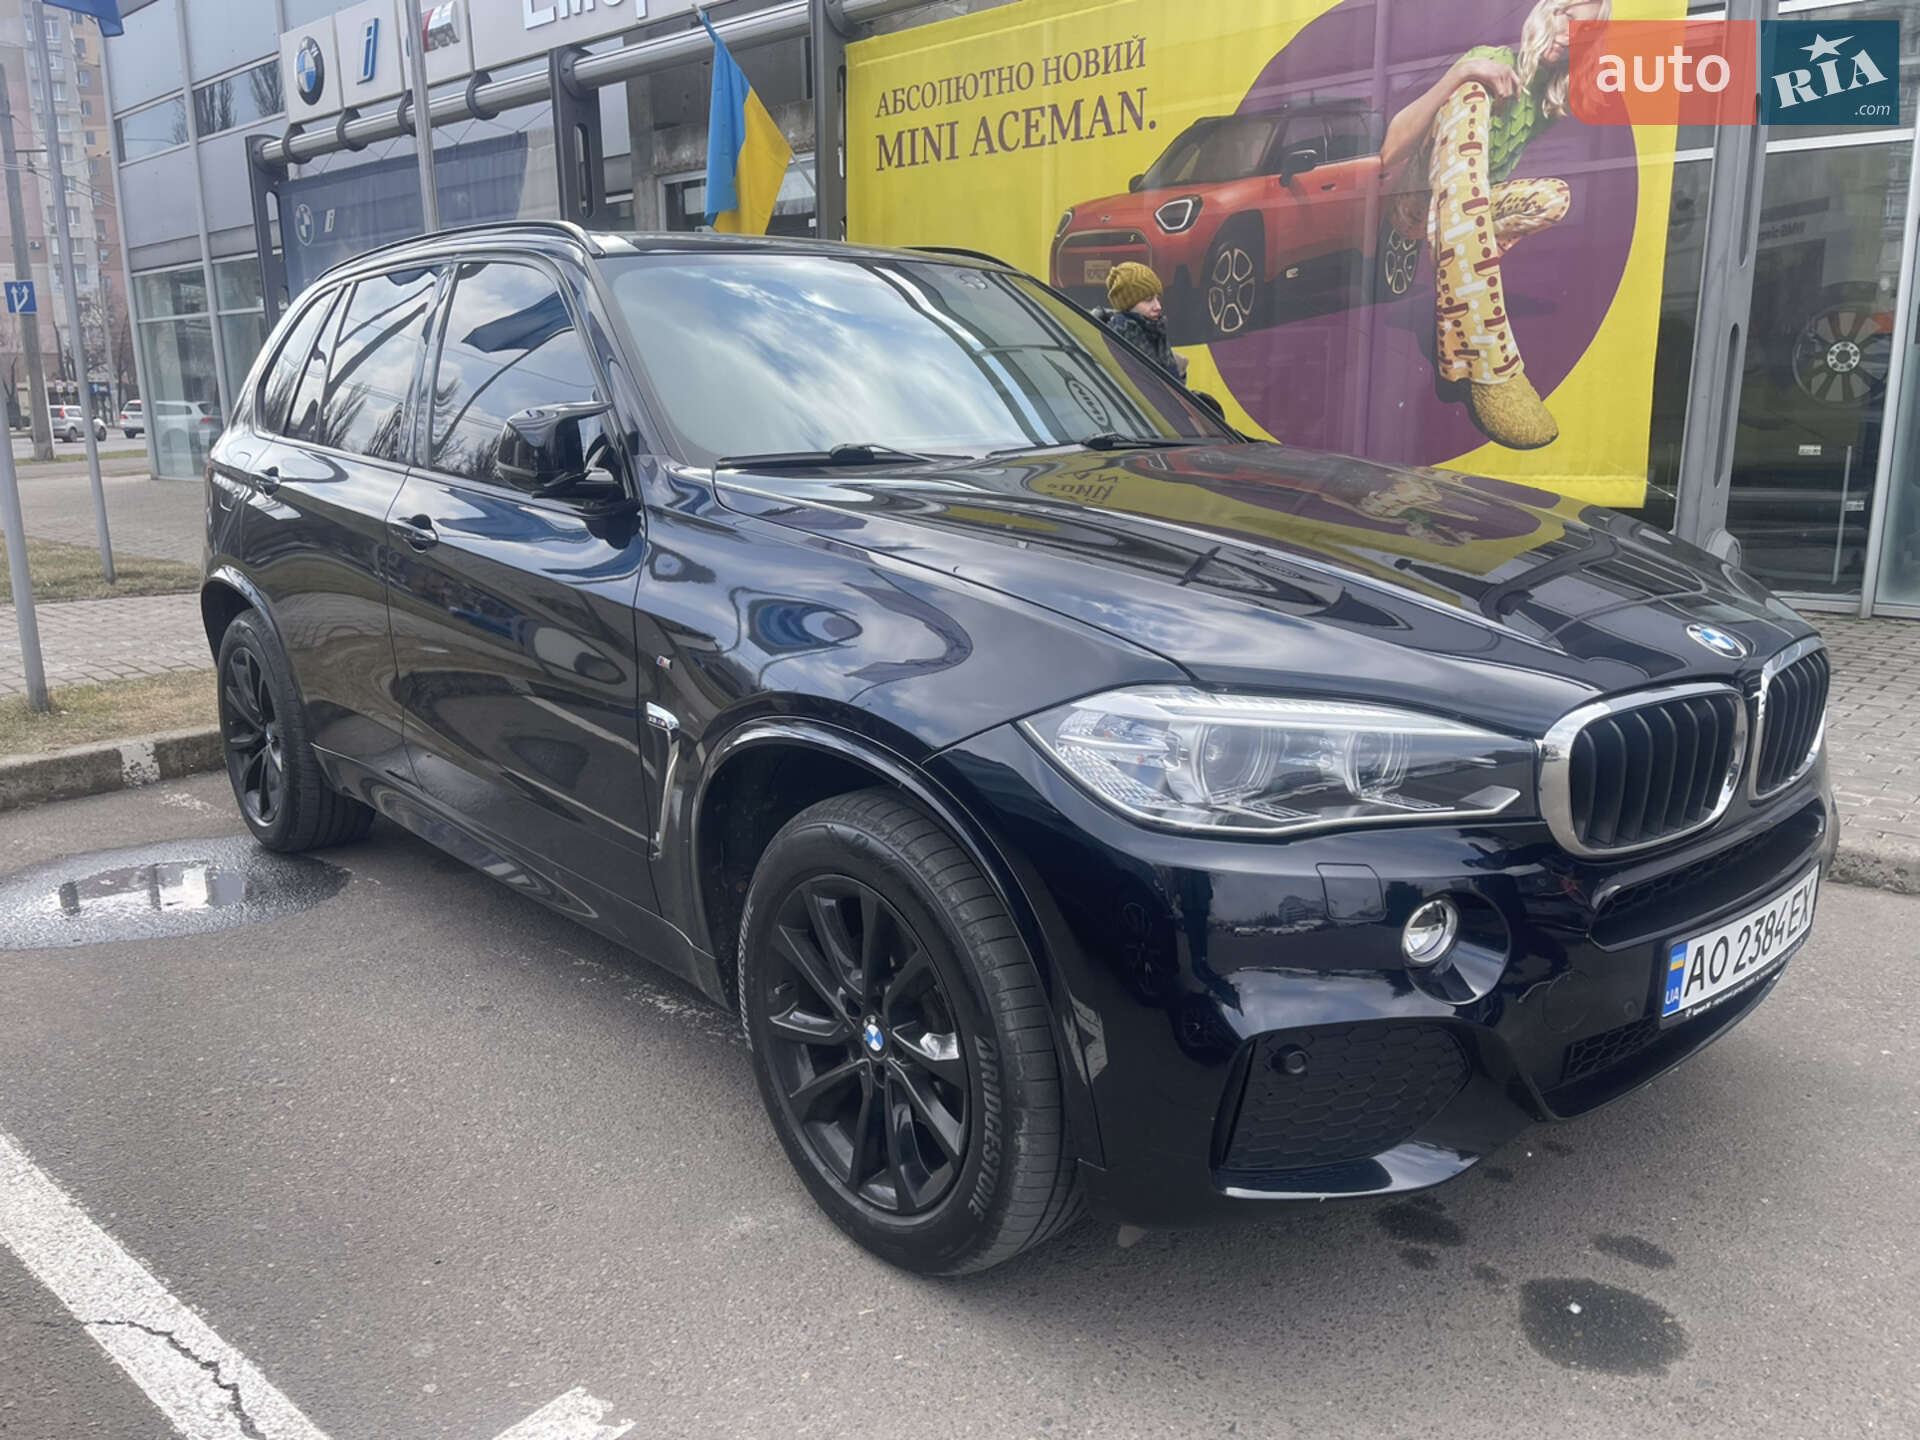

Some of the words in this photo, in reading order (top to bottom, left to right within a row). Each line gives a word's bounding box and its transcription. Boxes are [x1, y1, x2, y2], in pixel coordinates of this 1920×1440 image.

[875, 62, 1034, 118] АБСОЛЮТНО
[1042, 34, 1147, 87] НОВИЙ
[875, 121, 960, 172] MINI
[969, 87, 1157, 157] ACEMAN.
[1684, 935, 1730, 998] AO
[1733, 900, 1788, 975] 2384
[1787, 878, 1814, 939] EX
[1665, 986, 1681, 1005] UA
